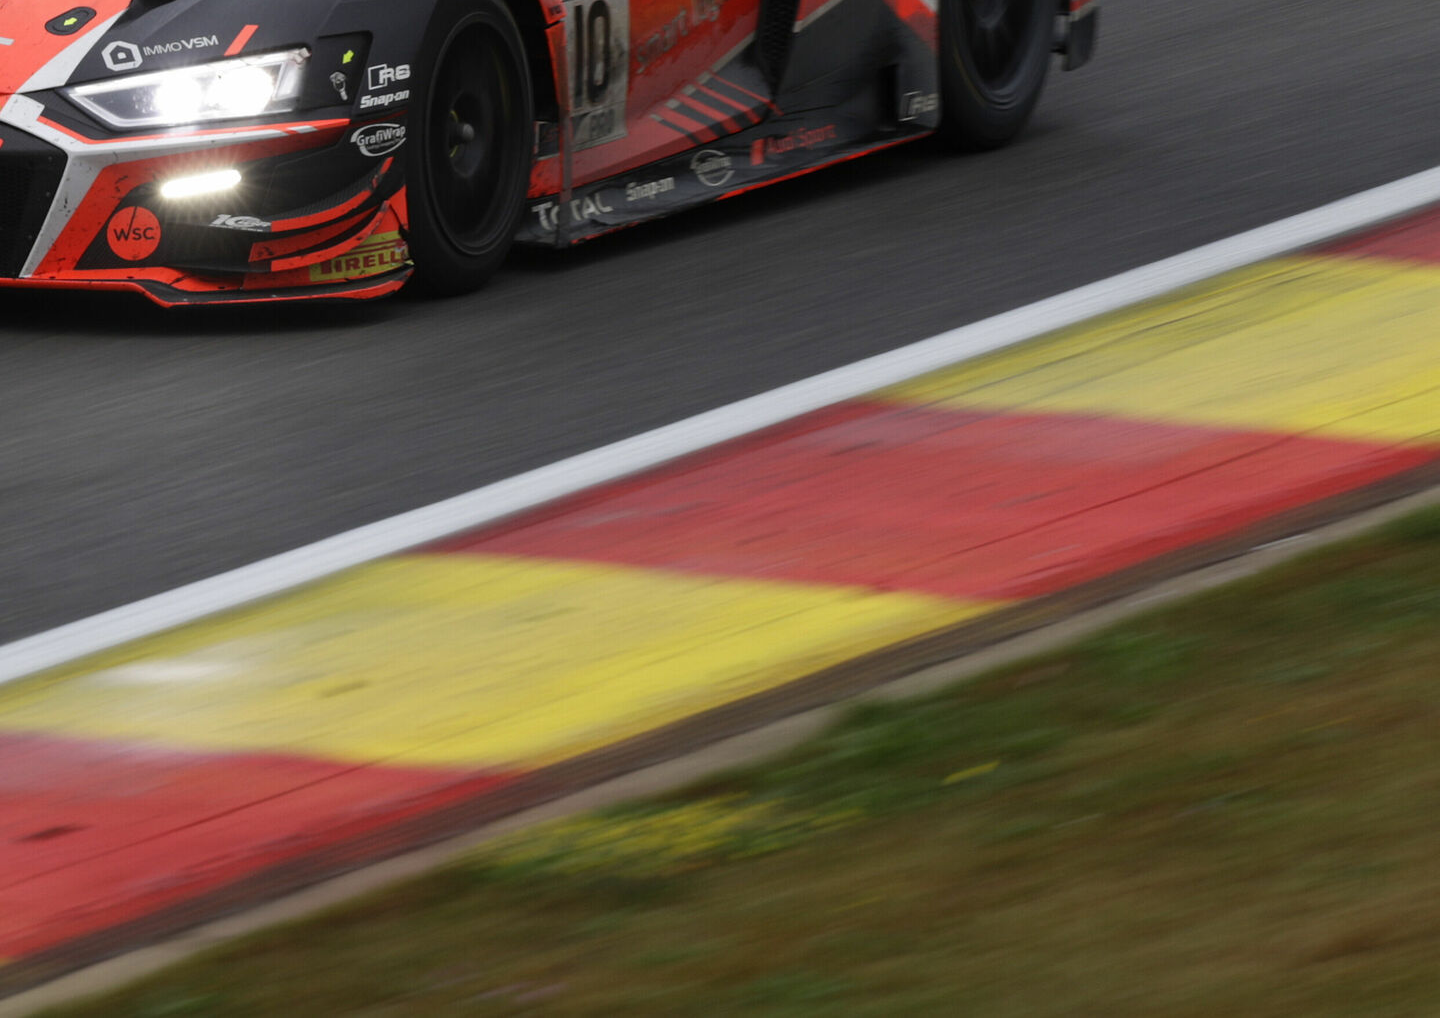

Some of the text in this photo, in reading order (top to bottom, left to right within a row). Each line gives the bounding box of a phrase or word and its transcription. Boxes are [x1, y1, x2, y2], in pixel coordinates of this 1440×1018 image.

[572, 0, 610, 107] 10
[360, 90, 409, 108] Snap-on
[113, 222, 155, 241] WSC
